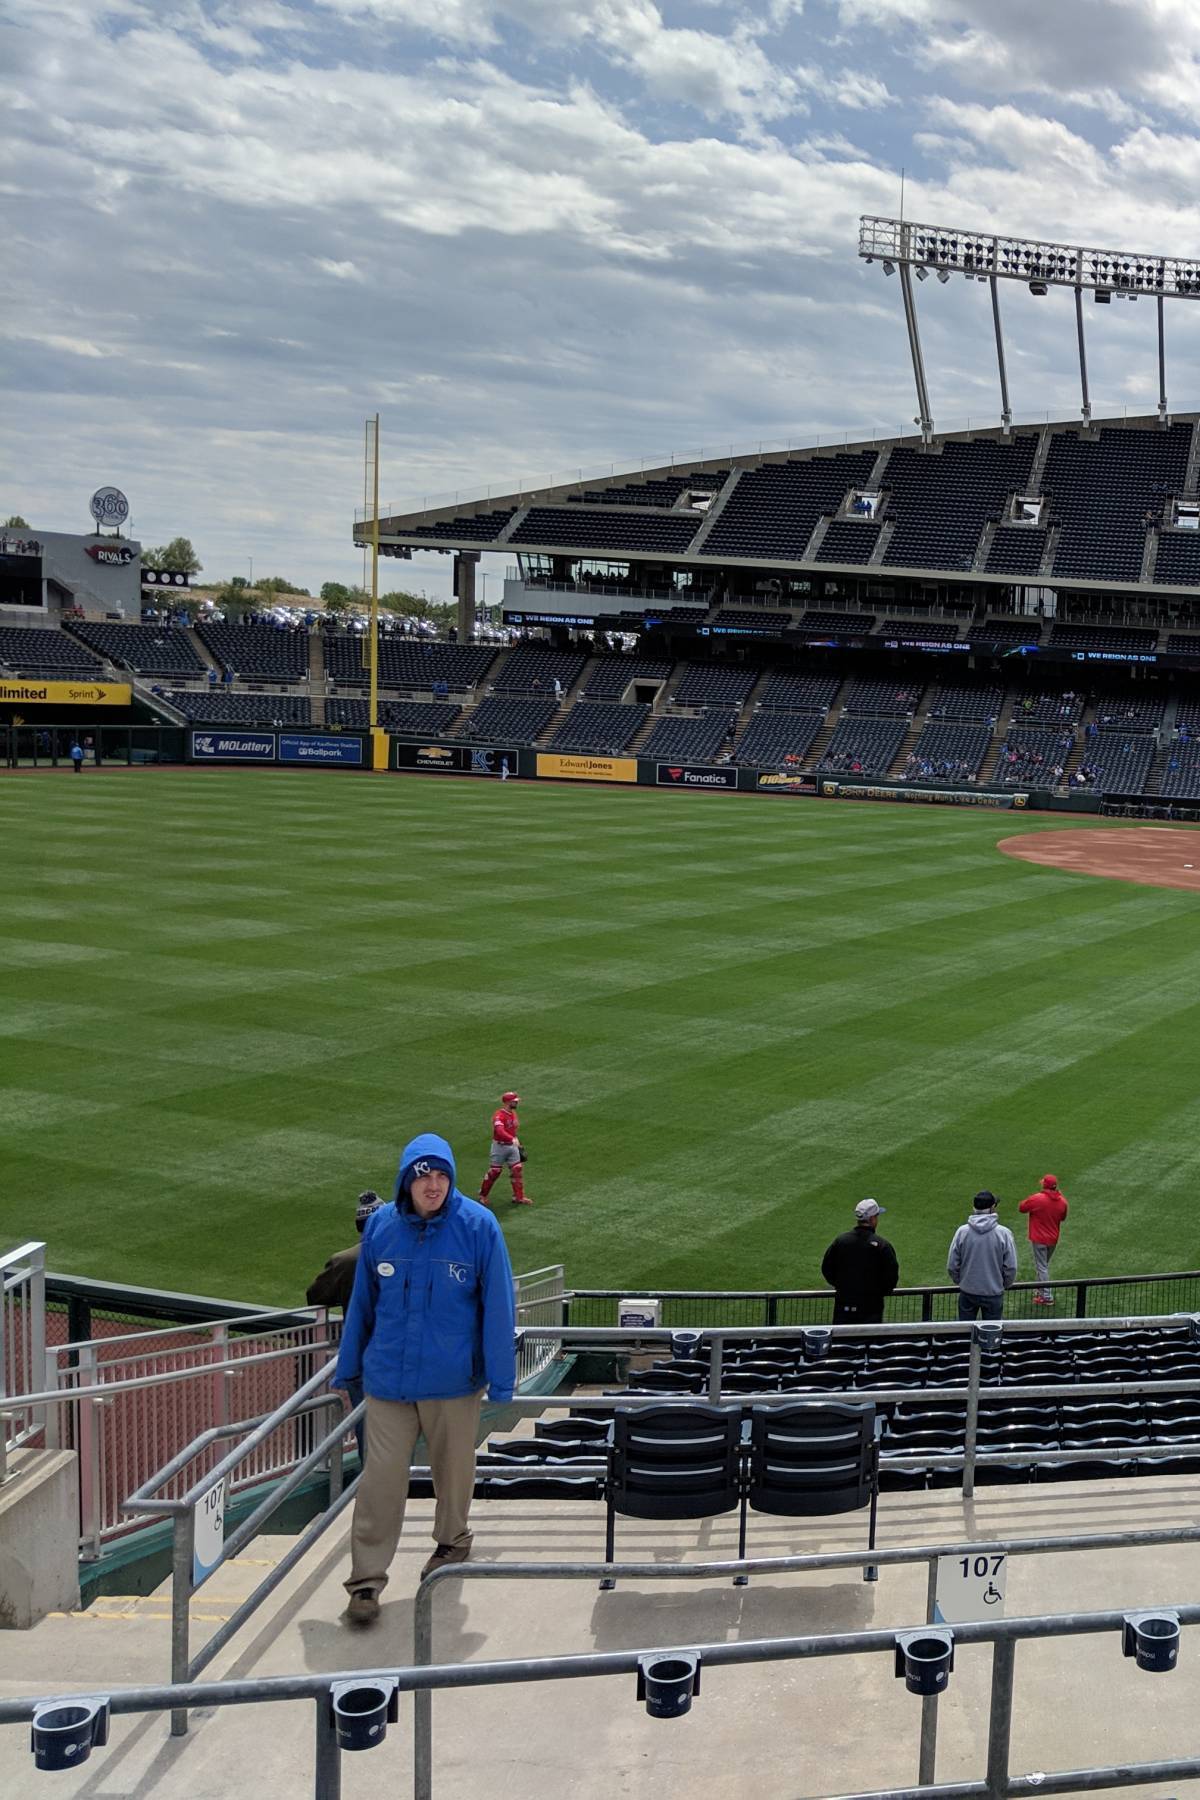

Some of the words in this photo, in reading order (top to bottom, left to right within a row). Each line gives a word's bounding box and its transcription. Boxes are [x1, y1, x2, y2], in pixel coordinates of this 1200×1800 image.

[92, 494, 128, 517] 360
[98, 551, 130, 562] RIVALS
[69, 690, 94, 700] Sprint
[218, 740, 272, 754] MOLottery
[308, 748, 342, 757] Ballpark
[471, 749, 495, 771] KC
[684, 771, 727, 784] Fanatics
[413, 1161, 431, 1177] KC
[449, 1263, 467, 1283] KC
[204, 1481, 223, 1515] 107
[959, 1555, 1005, 1578] 107
